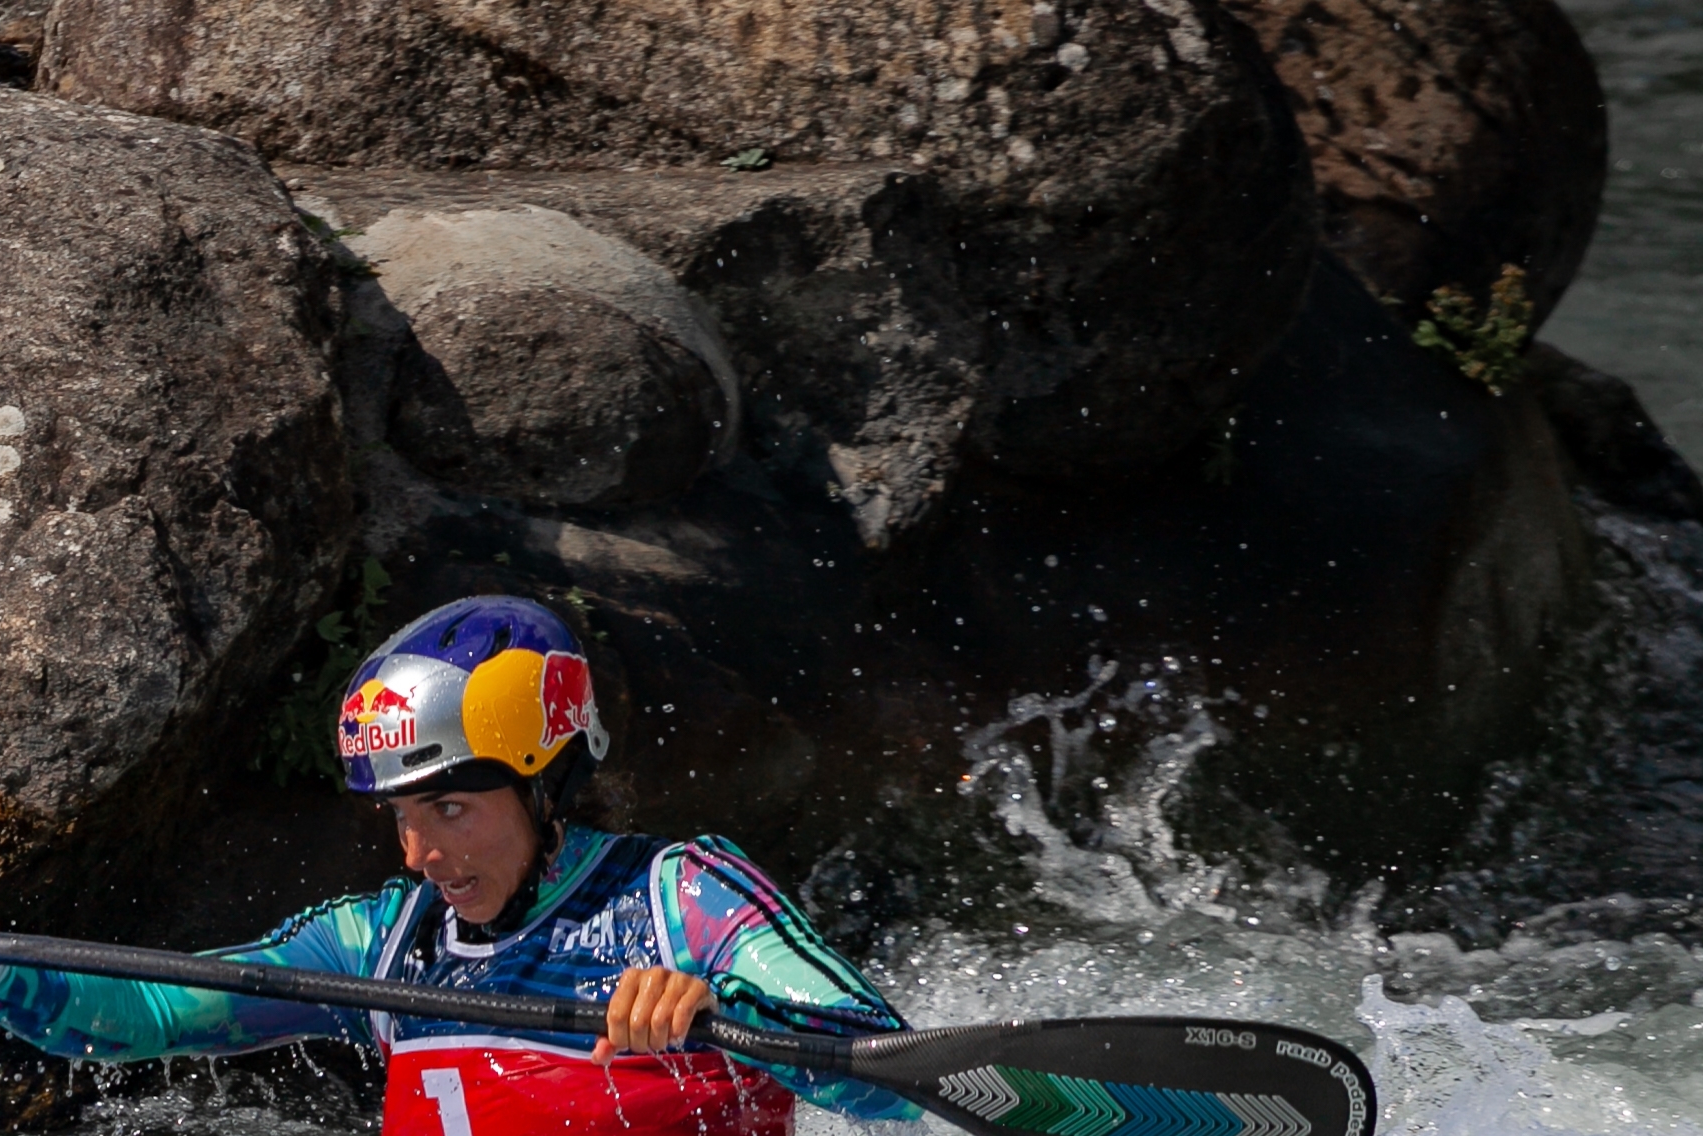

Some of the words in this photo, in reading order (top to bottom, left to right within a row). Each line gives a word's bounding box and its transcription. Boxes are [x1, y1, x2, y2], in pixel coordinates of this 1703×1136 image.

[338, 724, 366, 756] Red
[368, 718, 416, 752] Bull
[1185, 1026, 1256, 1049] X16-S
[1276, 1040, 1332, 1068] raab
